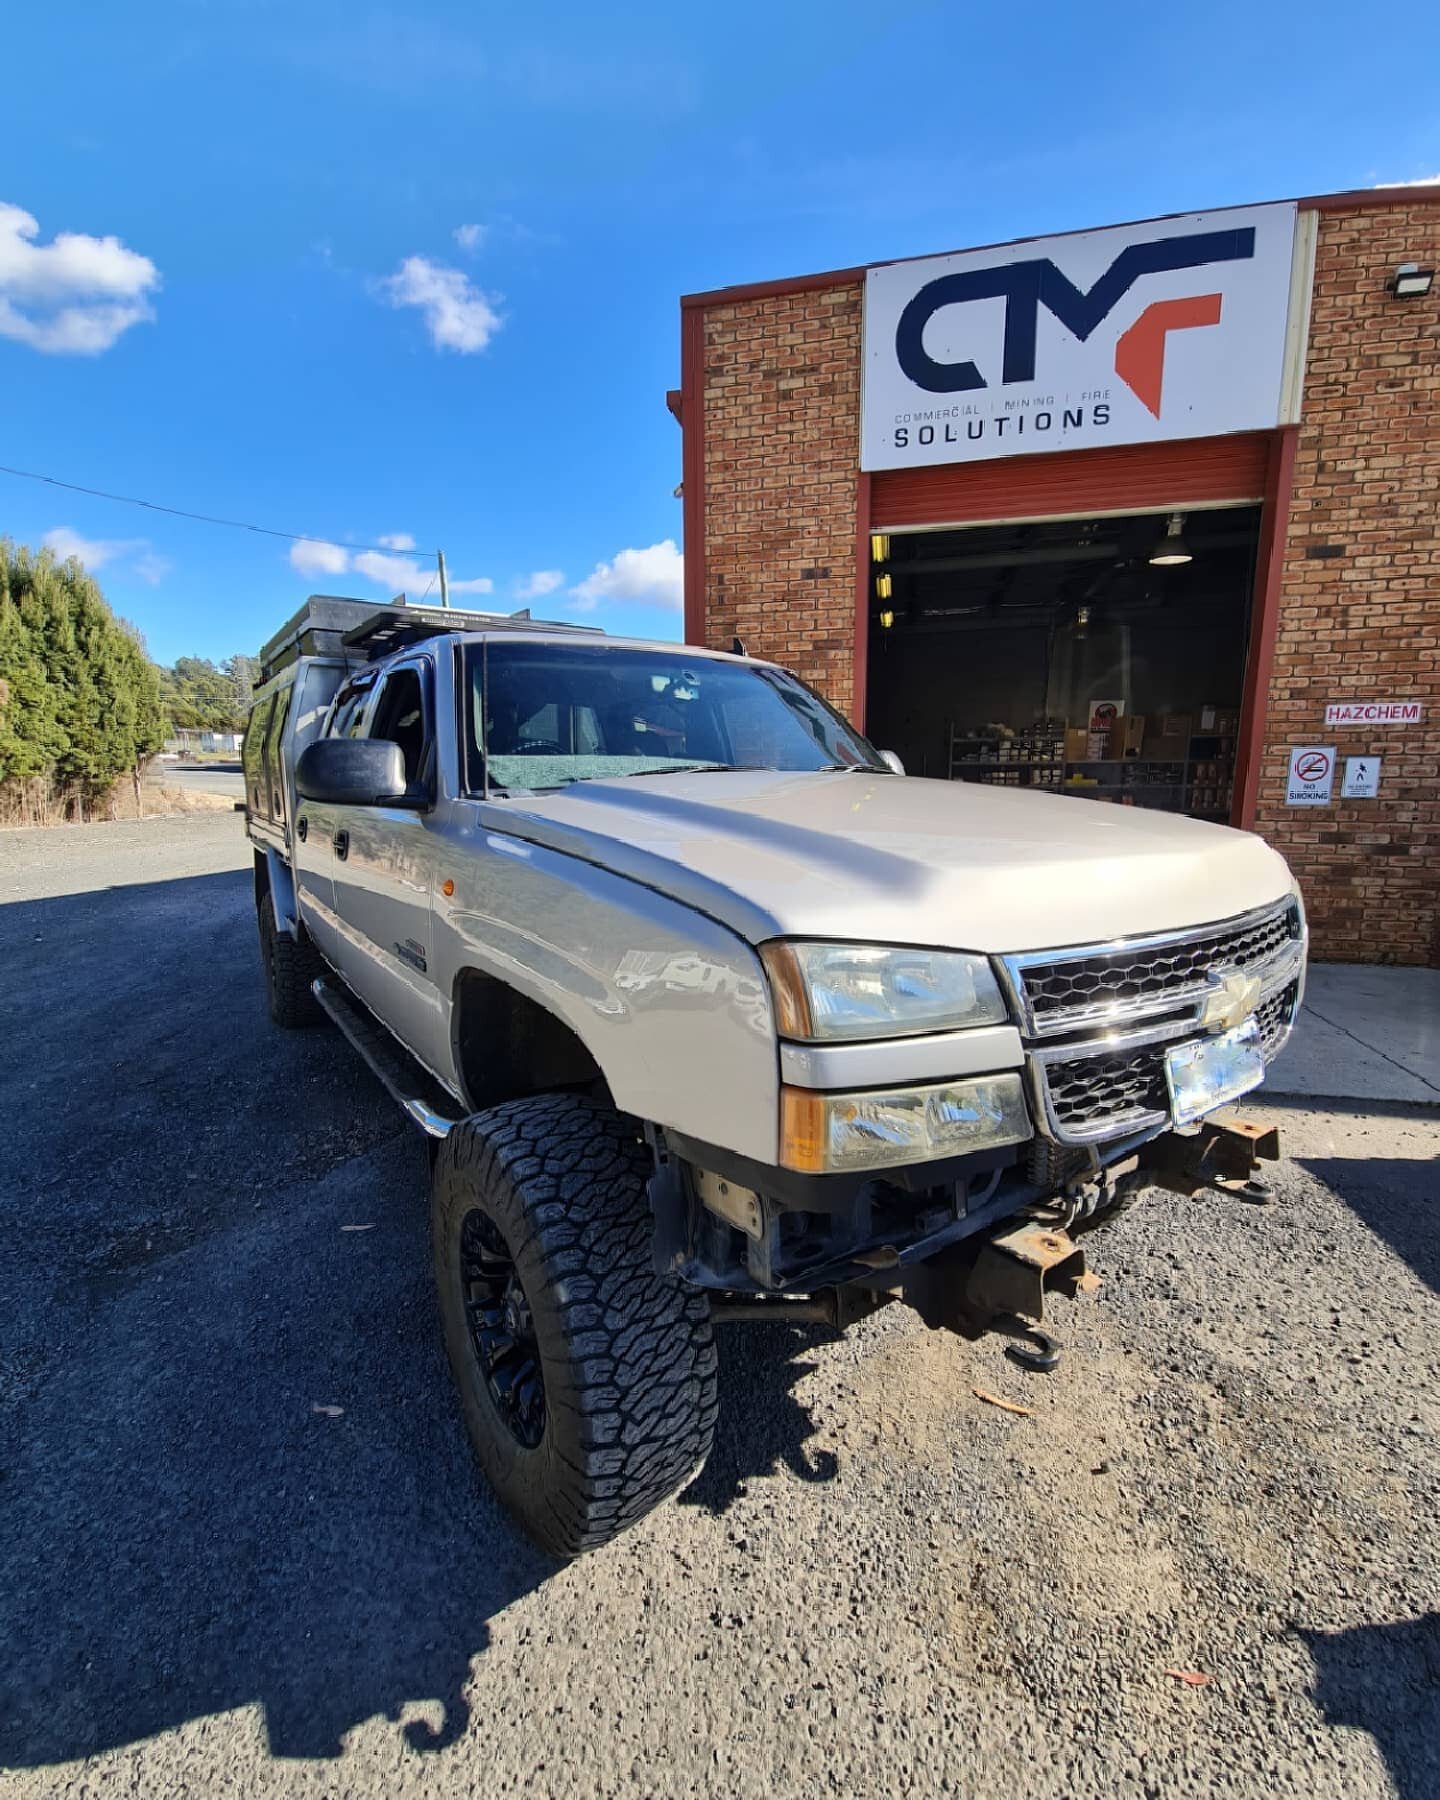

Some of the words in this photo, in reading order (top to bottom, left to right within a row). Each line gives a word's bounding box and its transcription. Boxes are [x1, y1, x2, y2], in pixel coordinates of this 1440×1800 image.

[894, 406, 980, 425] COMMERCIAL
[1004, 395, 1055, 411] MINING
[1081, 389, 1112, 402] FIRE
[894, 404, 1111, 449] SOLUTIONS
[1327, 705, 1419, 720] HAZCHEM
[1289, 791, 1329, 800] SMOKING
